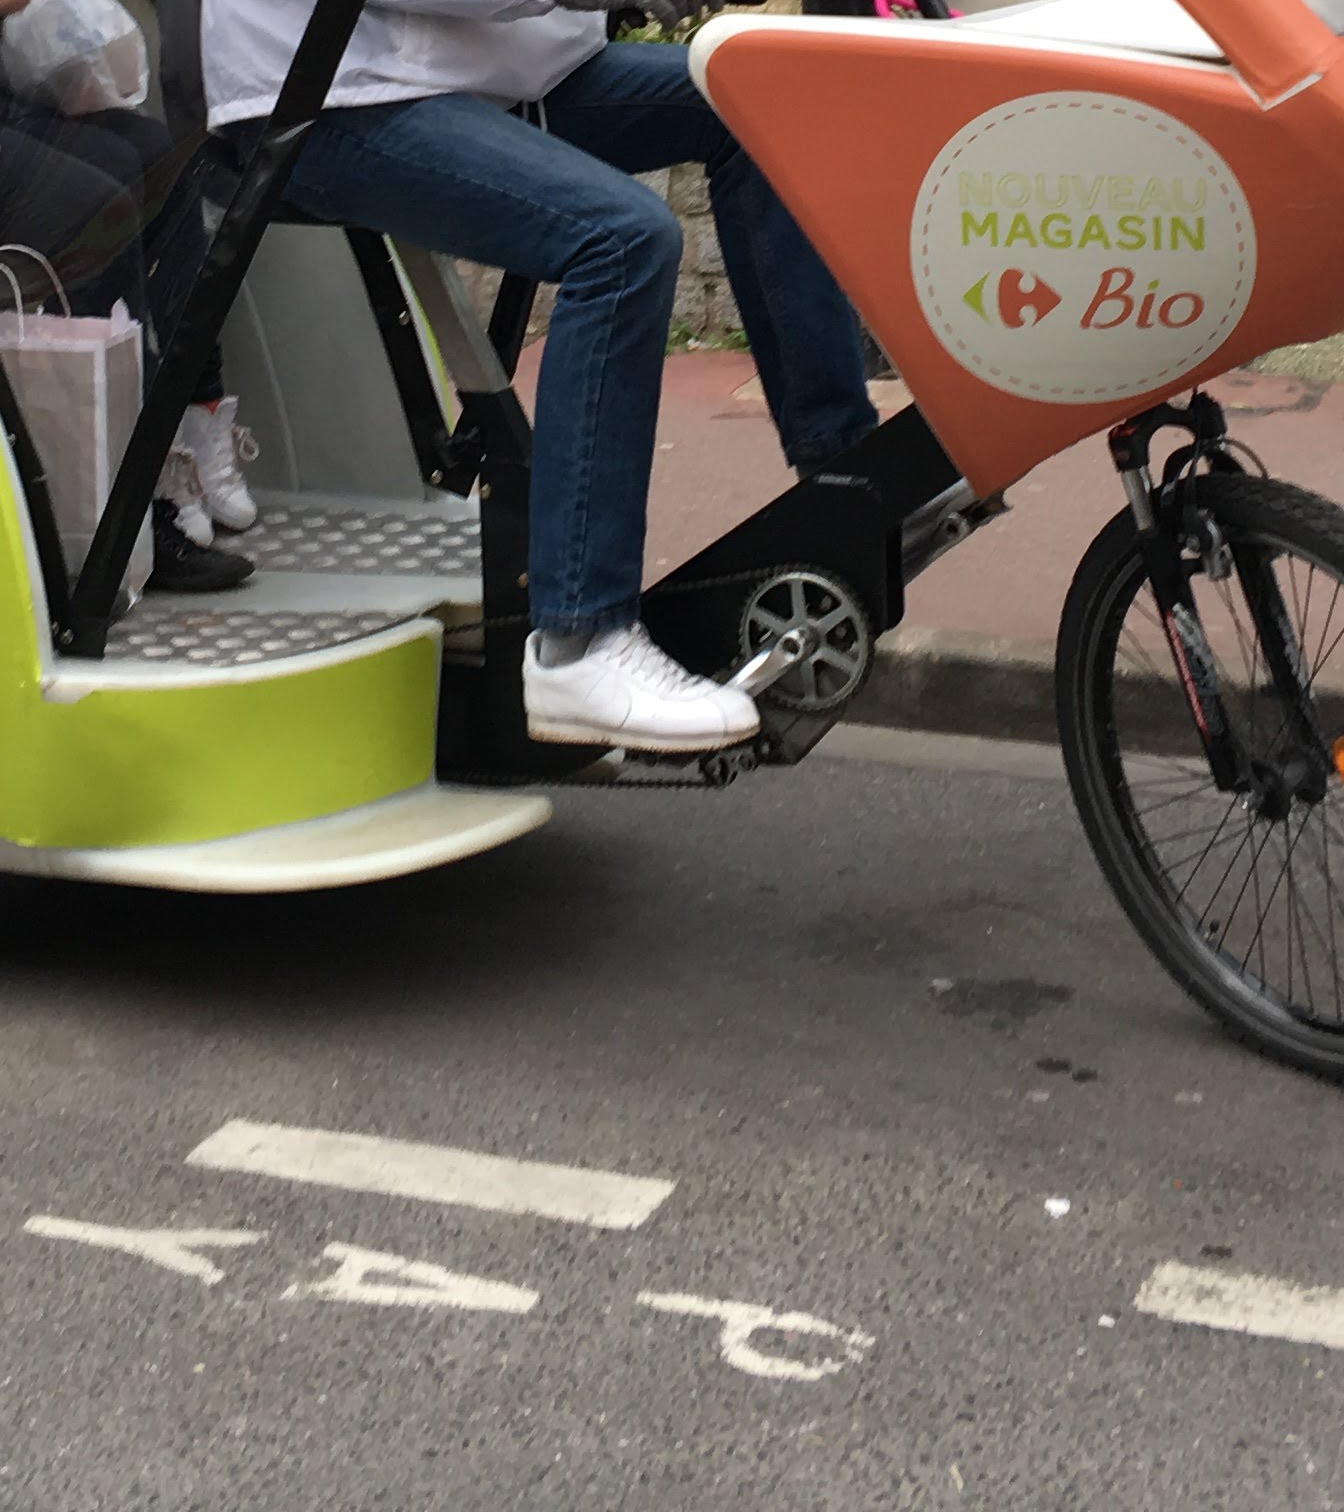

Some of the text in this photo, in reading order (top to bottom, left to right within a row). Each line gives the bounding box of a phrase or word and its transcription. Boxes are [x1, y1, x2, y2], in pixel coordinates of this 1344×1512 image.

[958, 171, 1207, 213] NOUVEAU
[961, 211, 1205, 251] MAGASIN
[1079, 267, 1205, 329] Bio
